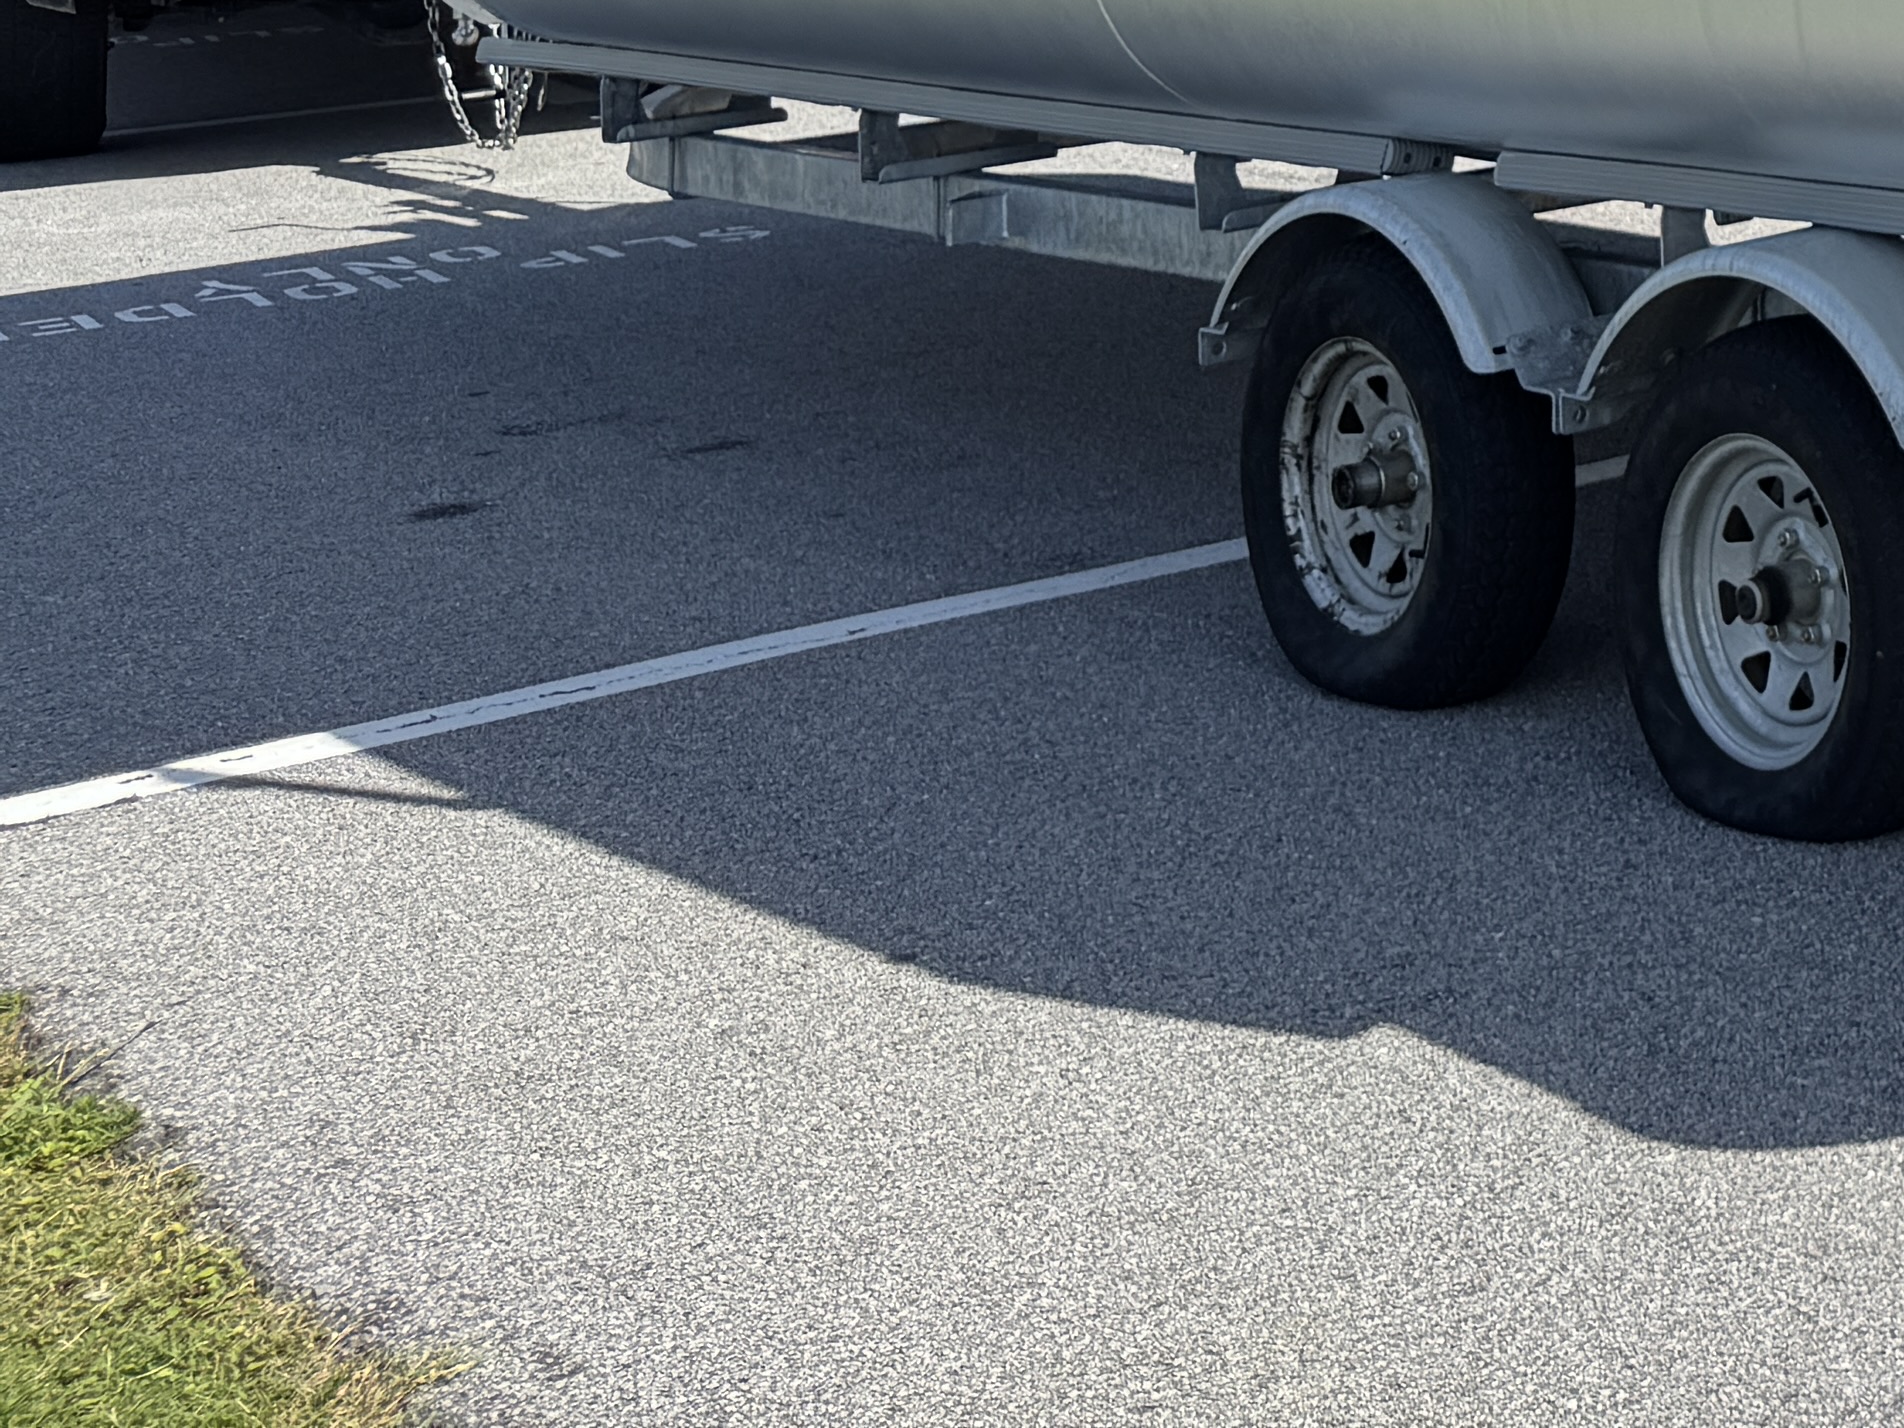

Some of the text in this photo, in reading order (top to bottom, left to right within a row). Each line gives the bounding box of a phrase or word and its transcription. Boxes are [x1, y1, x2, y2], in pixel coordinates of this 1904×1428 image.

[0, 224, 771, 341] SLIP HOLDE
[194, 245, 501, 298] ONLY
